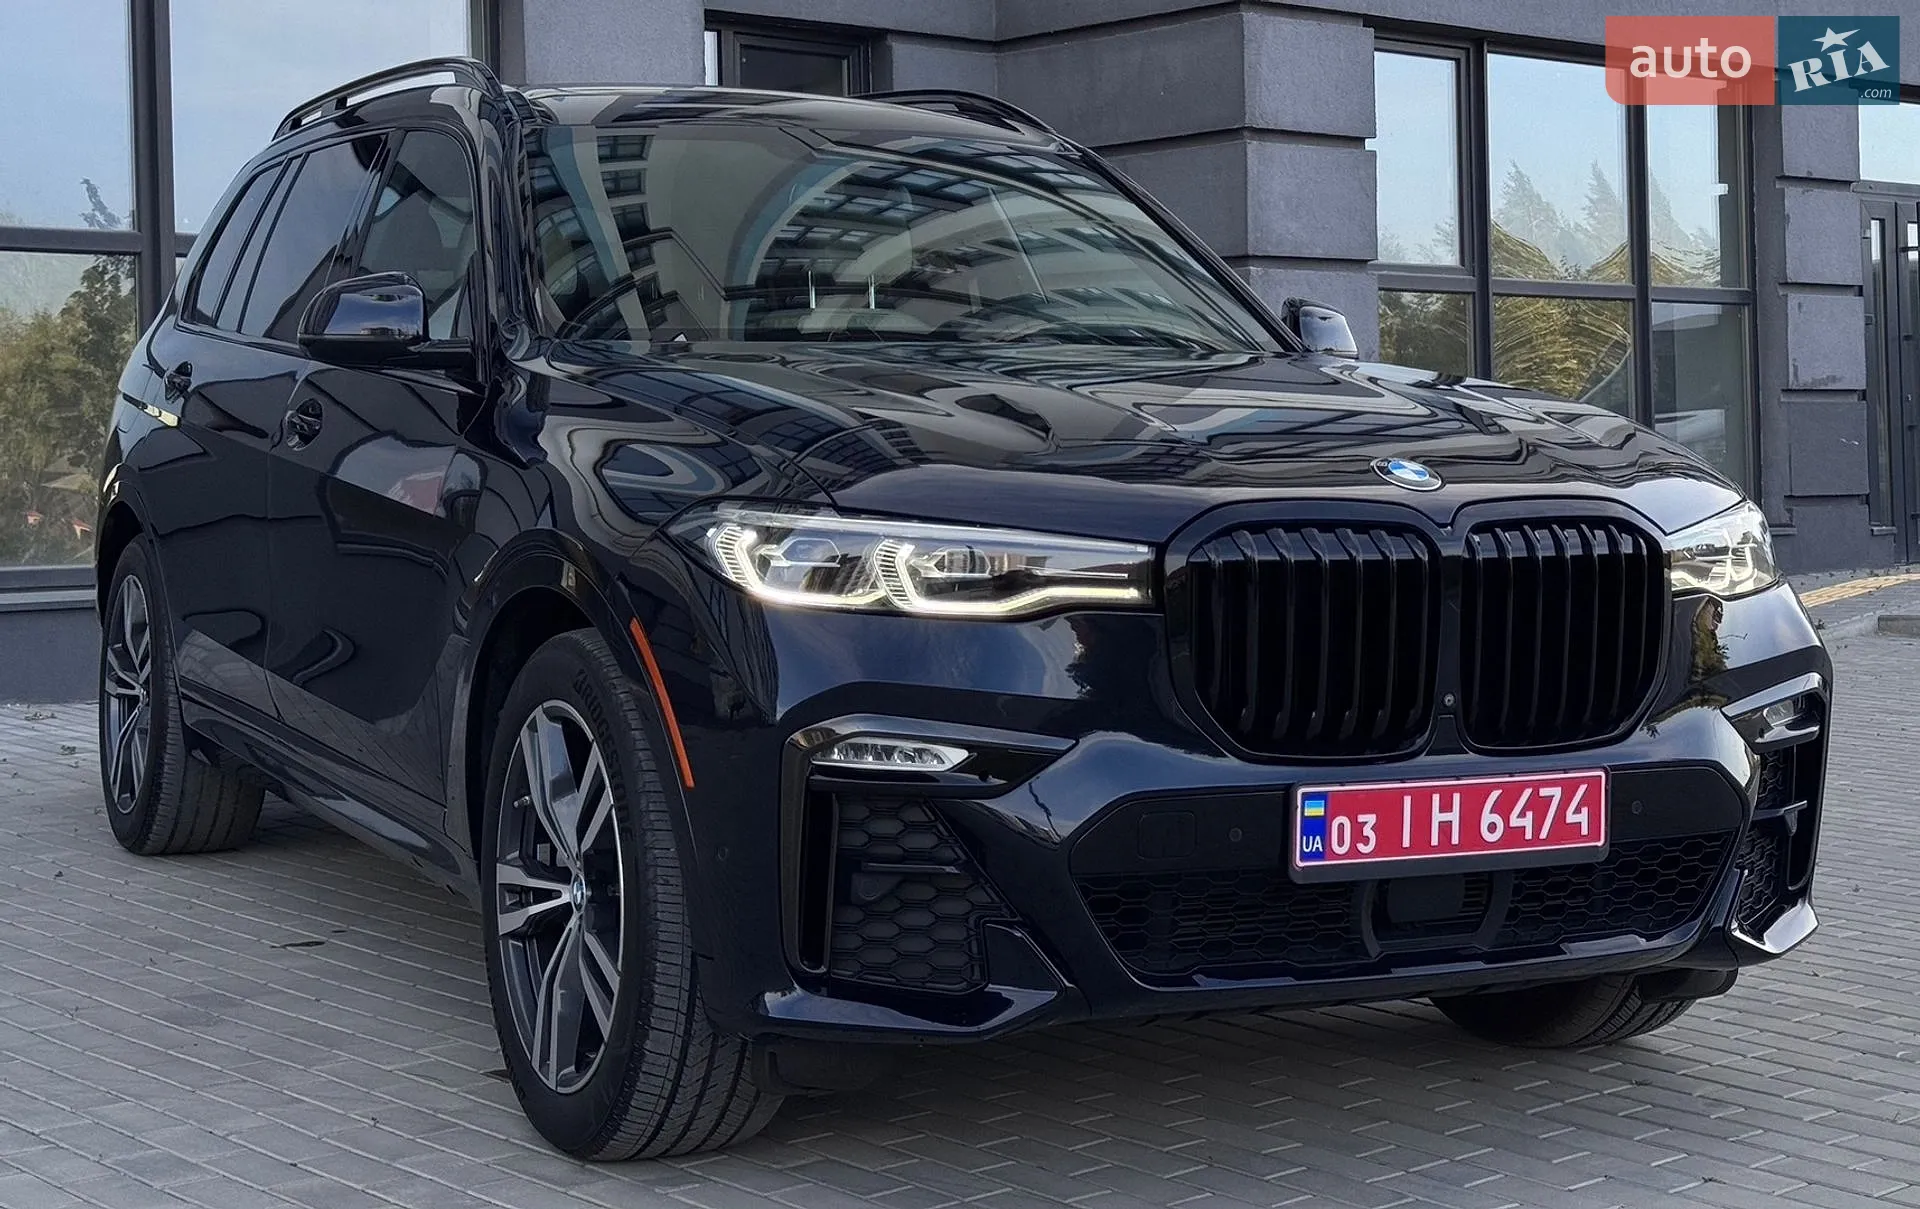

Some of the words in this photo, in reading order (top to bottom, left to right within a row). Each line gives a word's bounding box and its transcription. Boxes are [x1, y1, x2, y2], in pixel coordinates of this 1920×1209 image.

[572, 669, 633, 843] BRIDGESTONE
[1303, 835, 1323, 852] UA
[1331, 814, 1377, 855] 03
[1480, 784, 1589, 843] 6474
